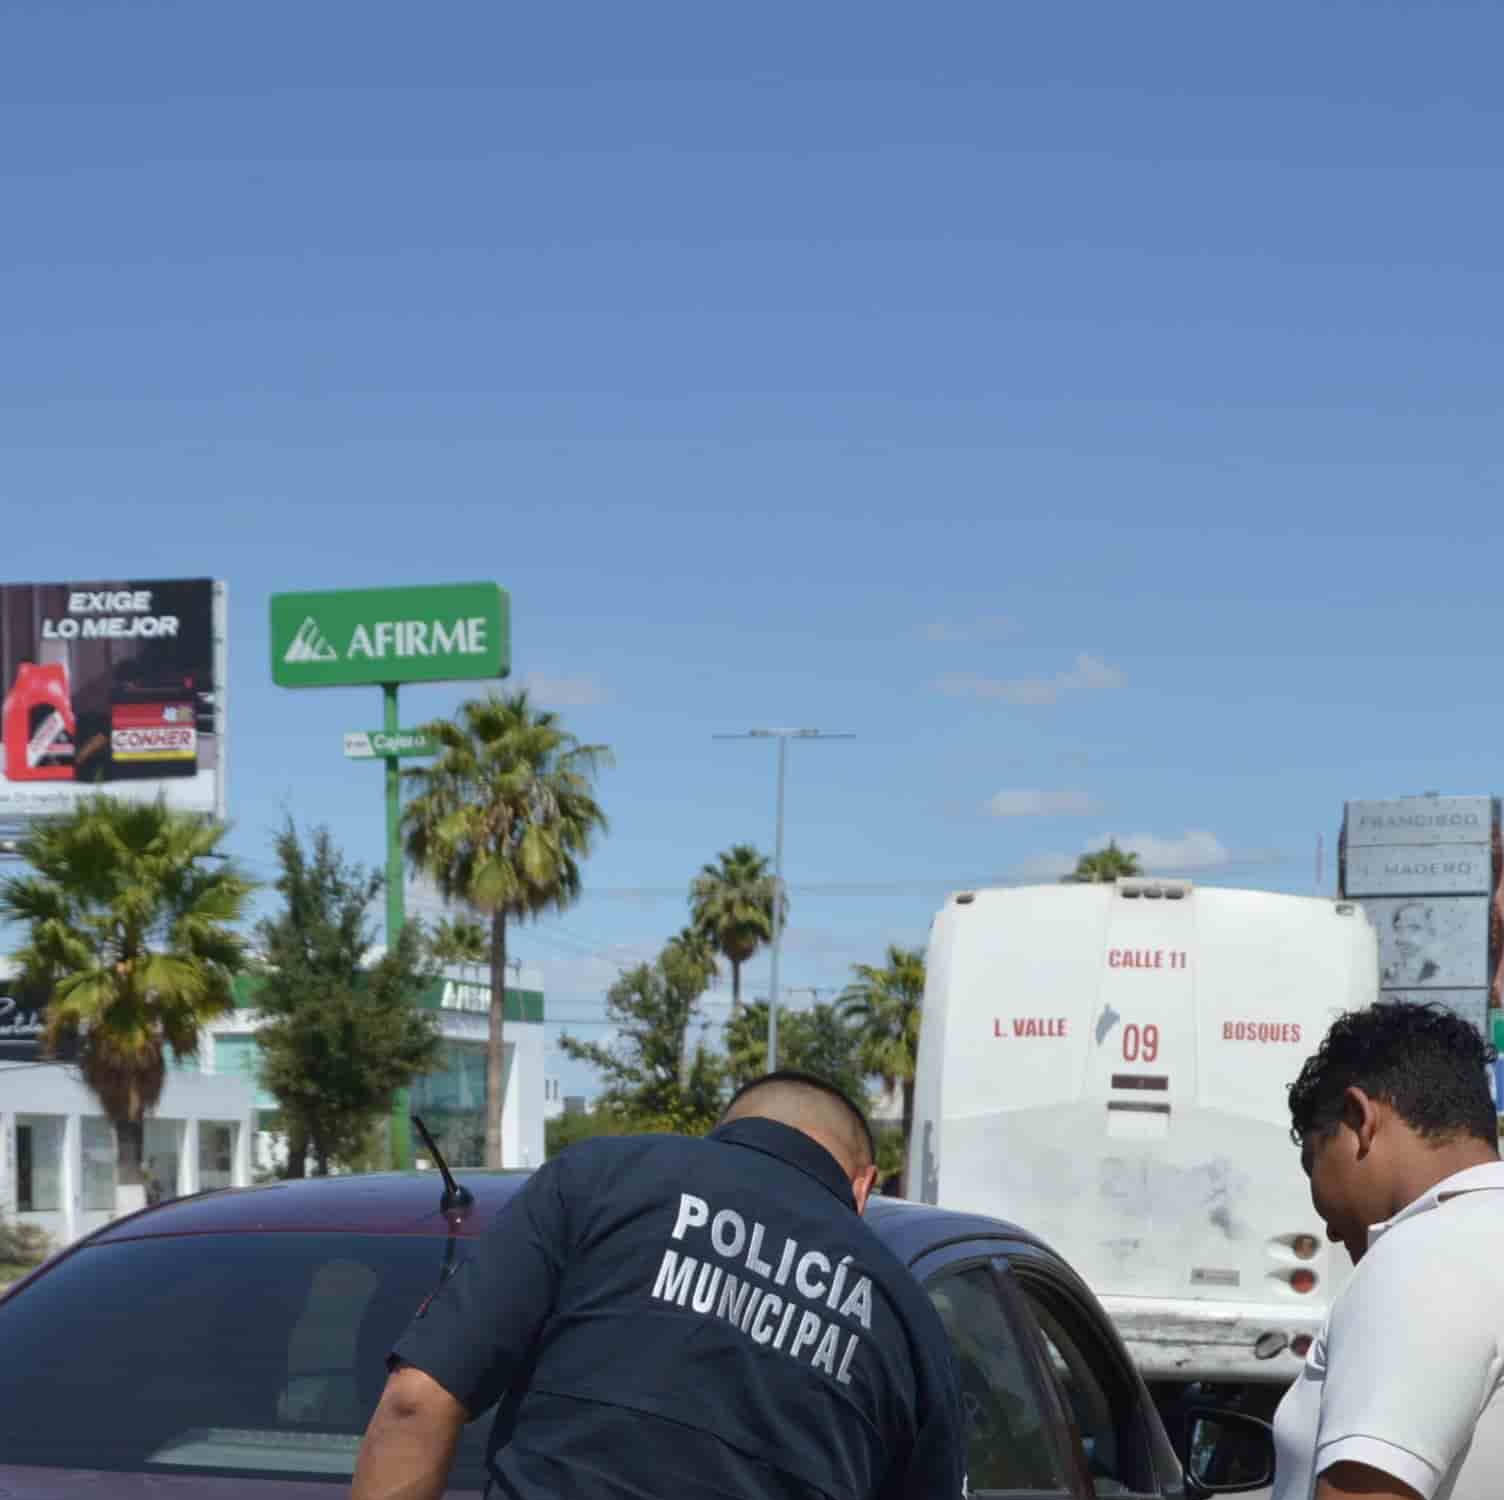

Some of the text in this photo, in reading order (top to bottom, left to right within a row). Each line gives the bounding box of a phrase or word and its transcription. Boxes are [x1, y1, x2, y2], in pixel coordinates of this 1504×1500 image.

[67, 590, 152, 613] EXIGE
[41, 616, 179, 639] LO MEJOR
[347, 617, 488, 660] AFIRME
[1108, 948, 1188, 969] CALLE 11
[993, 1017, 1068, 1038] L. VALLE
[1222, 1021, 1302, 1043] BOSQUES
[1122, 1023, 1160, 1062] 09
[672, 1193, 873, 1329] POLICÍA
[651, 1249, 860, 1384] MUNICIPAL
